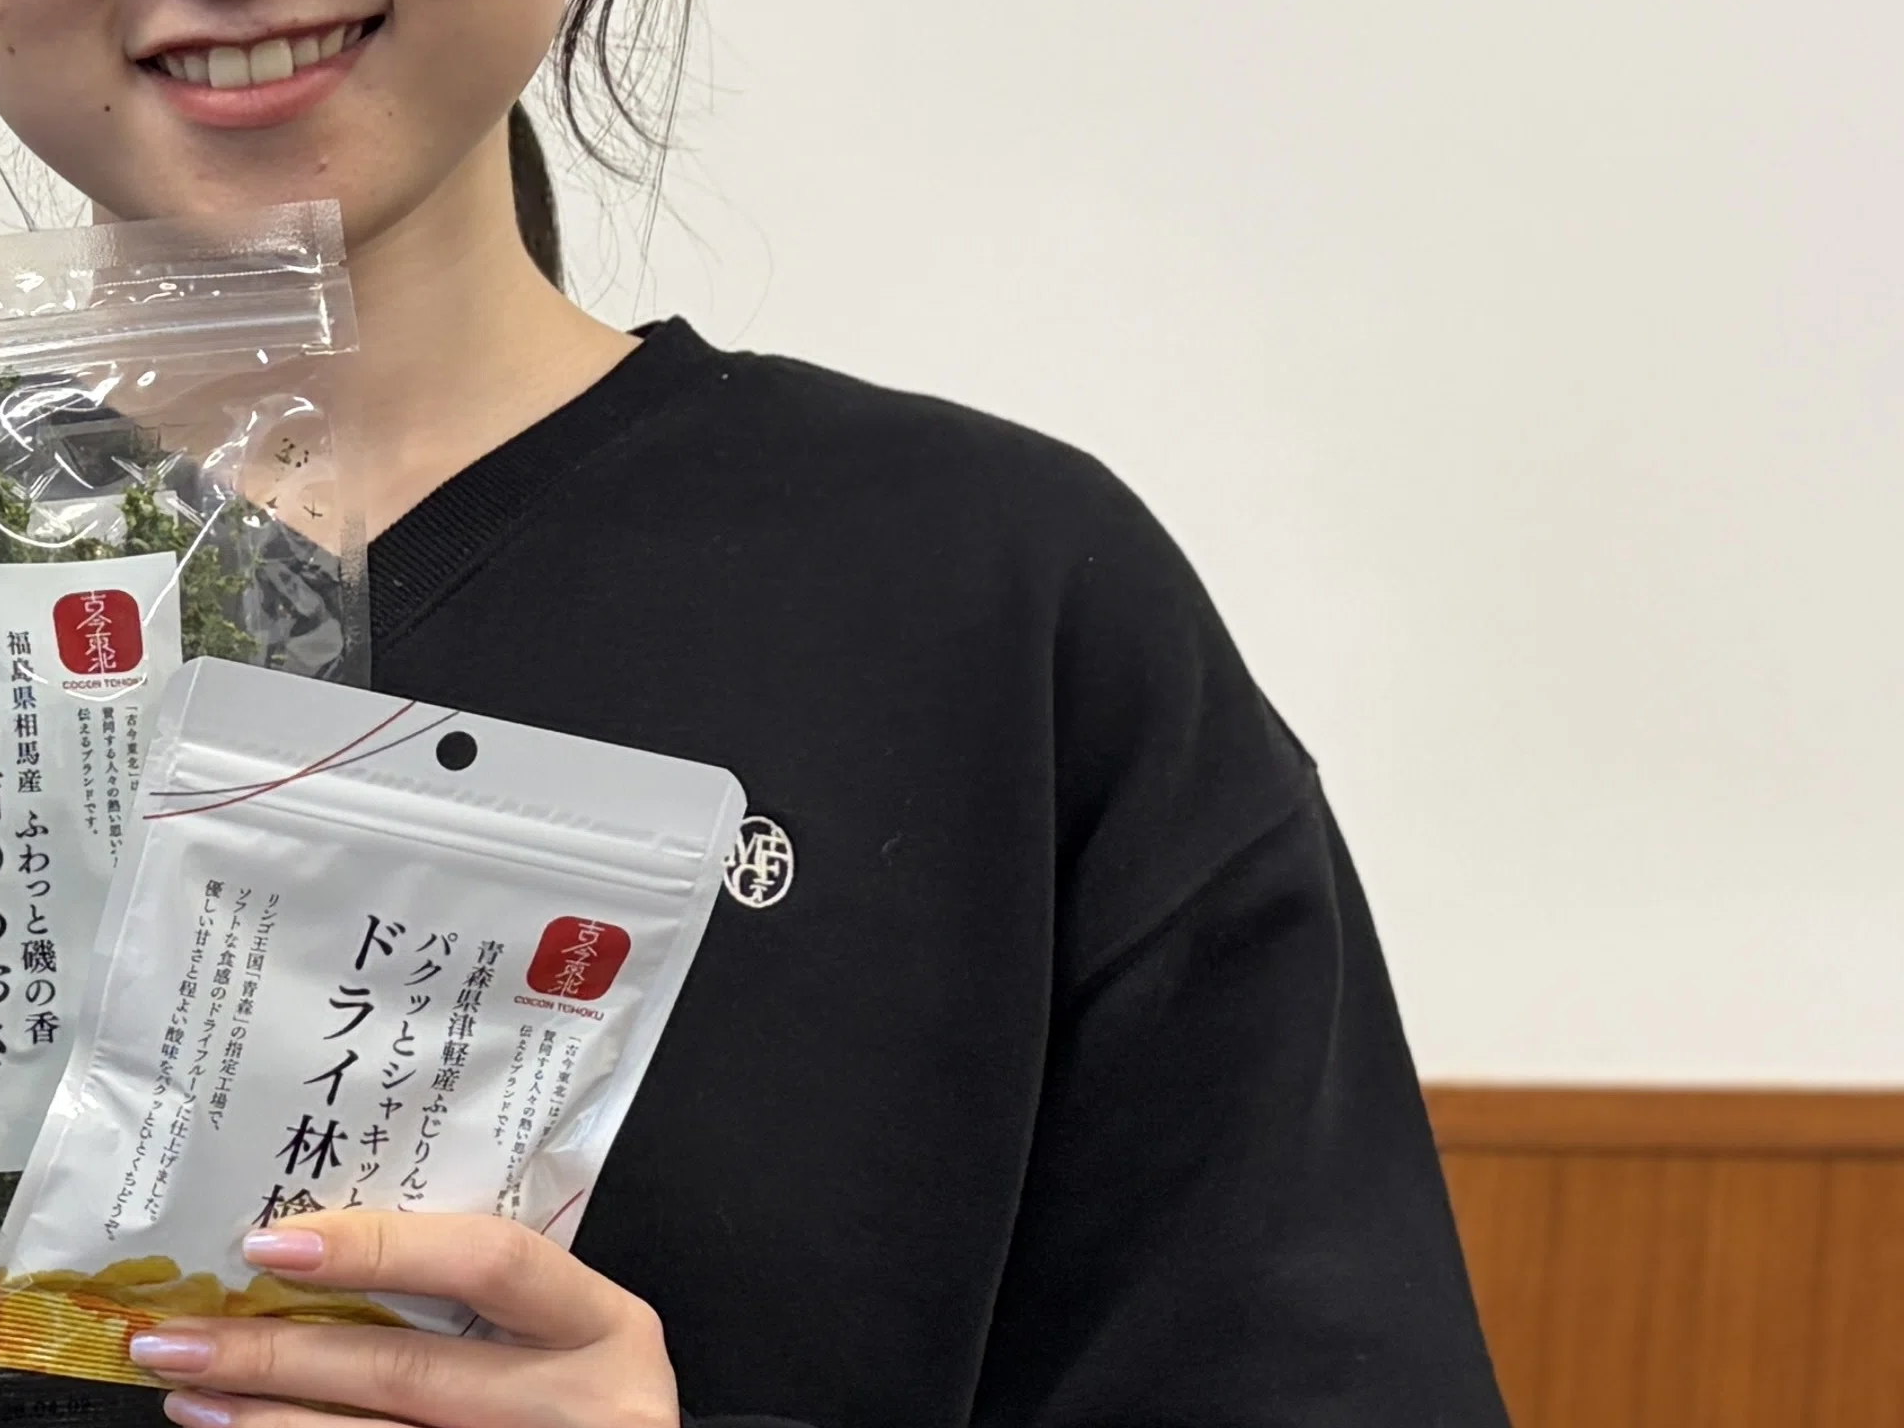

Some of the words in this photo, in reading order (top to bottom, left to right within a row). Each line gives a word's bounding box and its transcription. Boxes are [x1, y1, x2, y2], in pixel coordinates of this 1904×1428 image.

[7, 630, 42, 794] 福島県相馬産
[15, 811, 61, 1046] ふわっと磯の香
[547, 921, 606, 998] 古今東北
